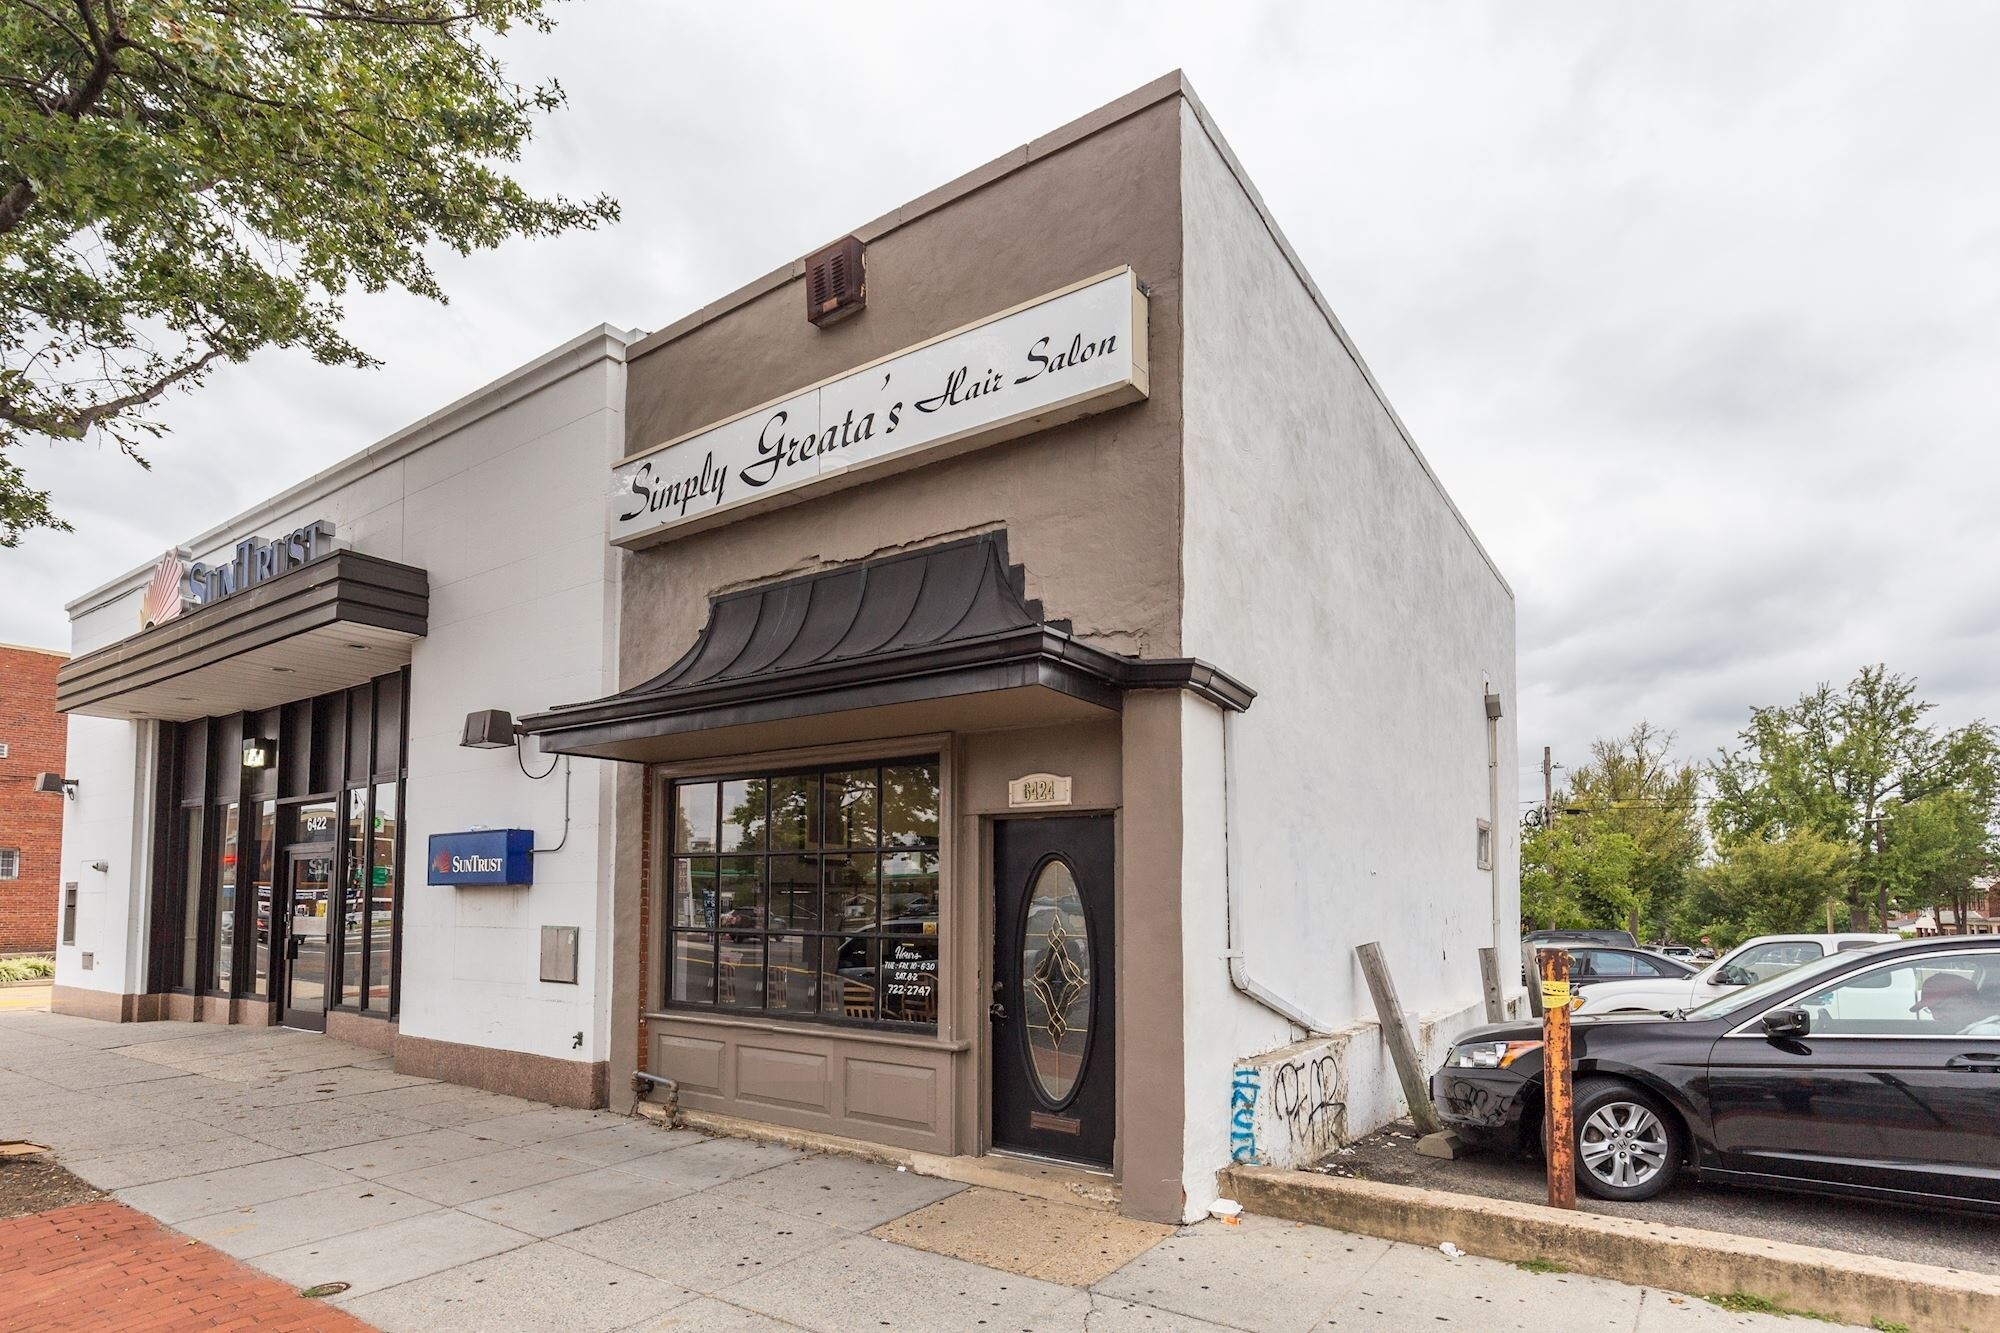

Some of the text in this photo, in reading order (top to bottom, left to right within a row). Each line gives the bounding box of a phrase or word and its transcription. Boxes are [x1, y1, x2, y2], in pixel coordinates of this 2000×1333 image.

[619, 332, 1118, 522] Simply Greata's Hair Salon
[1024, 780, 1055, 801] 6424
[307, 816, 327, 831] 6422
[894, 945, 922, 960] Hours
[887, 983, 931, 997] 722-2747
